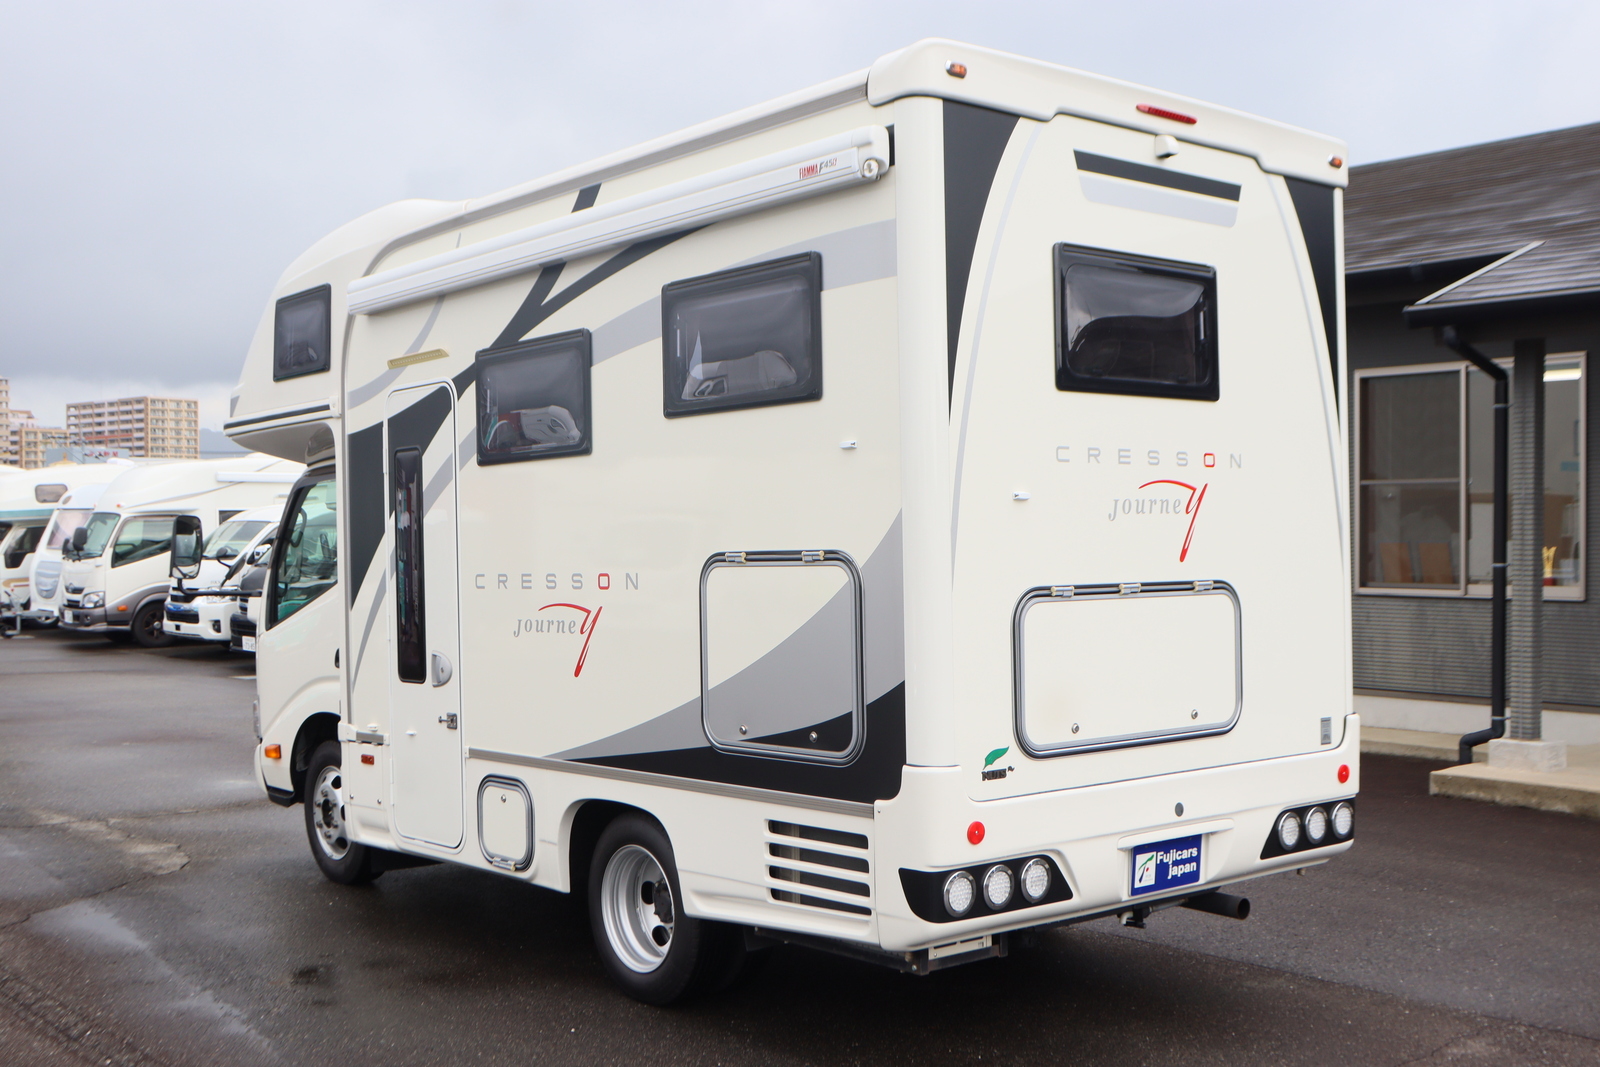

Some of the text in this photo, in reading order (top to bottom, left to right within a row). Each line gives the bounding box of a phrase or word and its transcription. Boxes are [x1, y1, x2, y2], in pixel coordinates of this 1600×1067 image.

[799, 163, 819, 179] FIAMMA
[1055, 445, 1242, 469] CRESSON
[474, 572, 639, 590] CRESSON
[1156, 847, 1198, 865] Fujicars
[1167, 862, 1197, 880] japan
